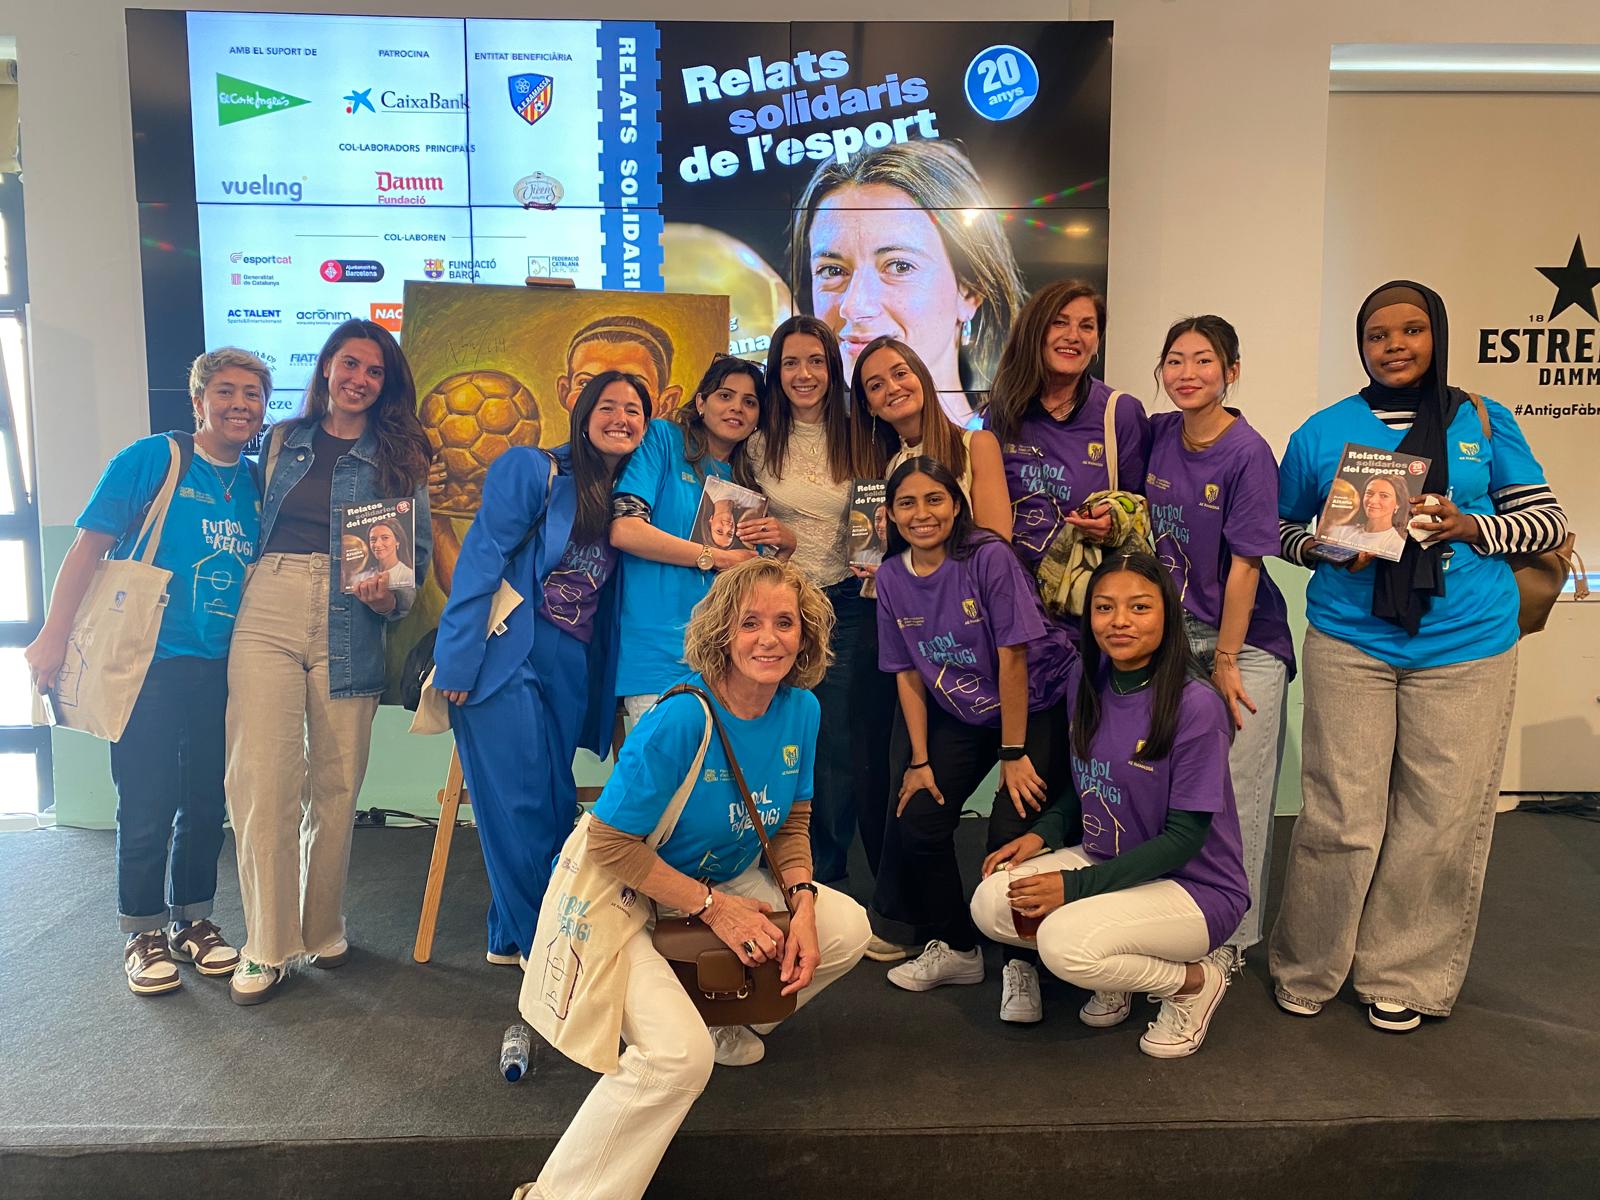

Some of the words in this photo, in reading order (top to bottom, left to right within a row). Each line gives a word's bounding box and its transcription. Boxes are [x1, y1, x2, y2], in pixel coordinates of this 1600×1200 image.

[229, 46, 250, 55] AMB
[253, 46, 264, 55] EL
[266, 47, 302, 56] SUPORT
[305, 48, 317, 56] DE
[378, 49, 430, 59] PATROCINA
[474, 52, 509, 61] ENTITAT
[682, 50, 850, 105] Relats
[977, 52, 1021, 95] 20
[618, 37, 638, 144] RELATS
[988, 85, 1025, 107] anys
[380, 90, 470, 110] CaixaBank
[728, 73, 930, 135] solidaris
[679, 145, 740, 183] de
[747, 107, 940, 172] l'esport
[375, 170, 444, 192] Damm
[221, 174, 302, 202] vueling
[377, 194, 426, 205] Fundació
[620, 159, 641, 291] SOLIDARI
[243, 255, 292, 266] esportcat
[448, 258, 497, 270] FUNDACIÓ
[448, 270, 481, 280] BARÇA
[228, 309, 242, 318] AC
[243, 309, 282, 318] TALENT
[1529, 314, 1545, 323] 18
[1478, 328, 1600, 364] ESTRE
[1538, 367, 1600, 386] DAMM
[269, 400, 293, 410] eze
[1348, 451, 1392, 461] Relatos
[1342, 465, 1360, 473] del
[1361, 466, 1406, 476] deporte
[1356, 460, 1408, 469] solidarios
[857, 483, 886, 493] Relats
[855, 496, 866, 505] de
[346, 502, 383, 516] Relatos
[345, 519, 361, 529] del
[361, 511, 397, 525] deporte
[201, 518, 247, 537] FUTBOL
